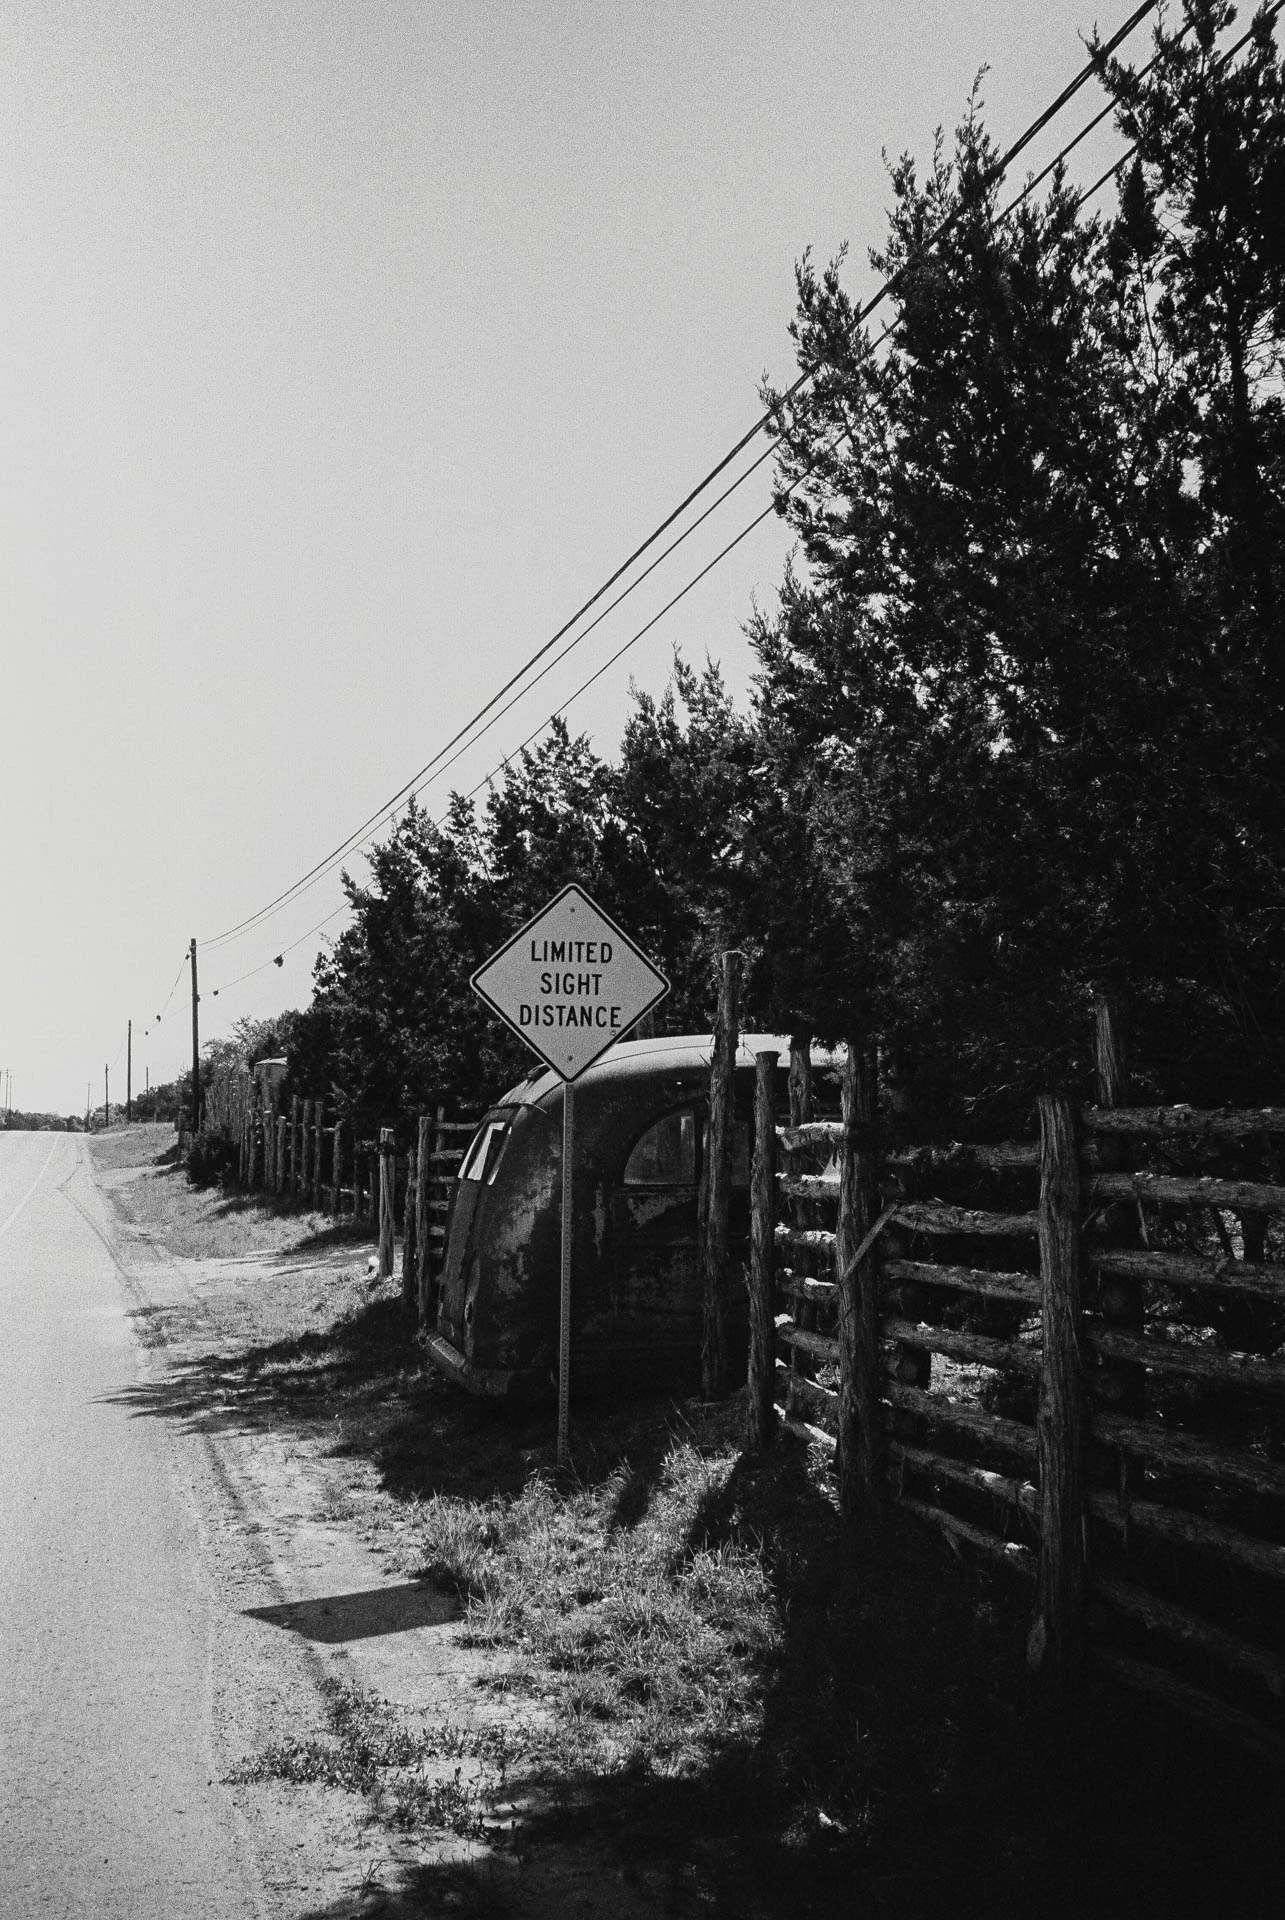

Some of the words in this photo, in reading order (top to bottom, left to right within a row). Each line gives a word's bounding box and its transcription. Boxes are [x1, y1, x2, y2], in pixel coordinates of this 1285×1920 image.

[530, 939, 613, 964] LIMITED
[539, 972, 603, 996] SIGHT
[519, 1004, 622, 1029] DISTANCE
